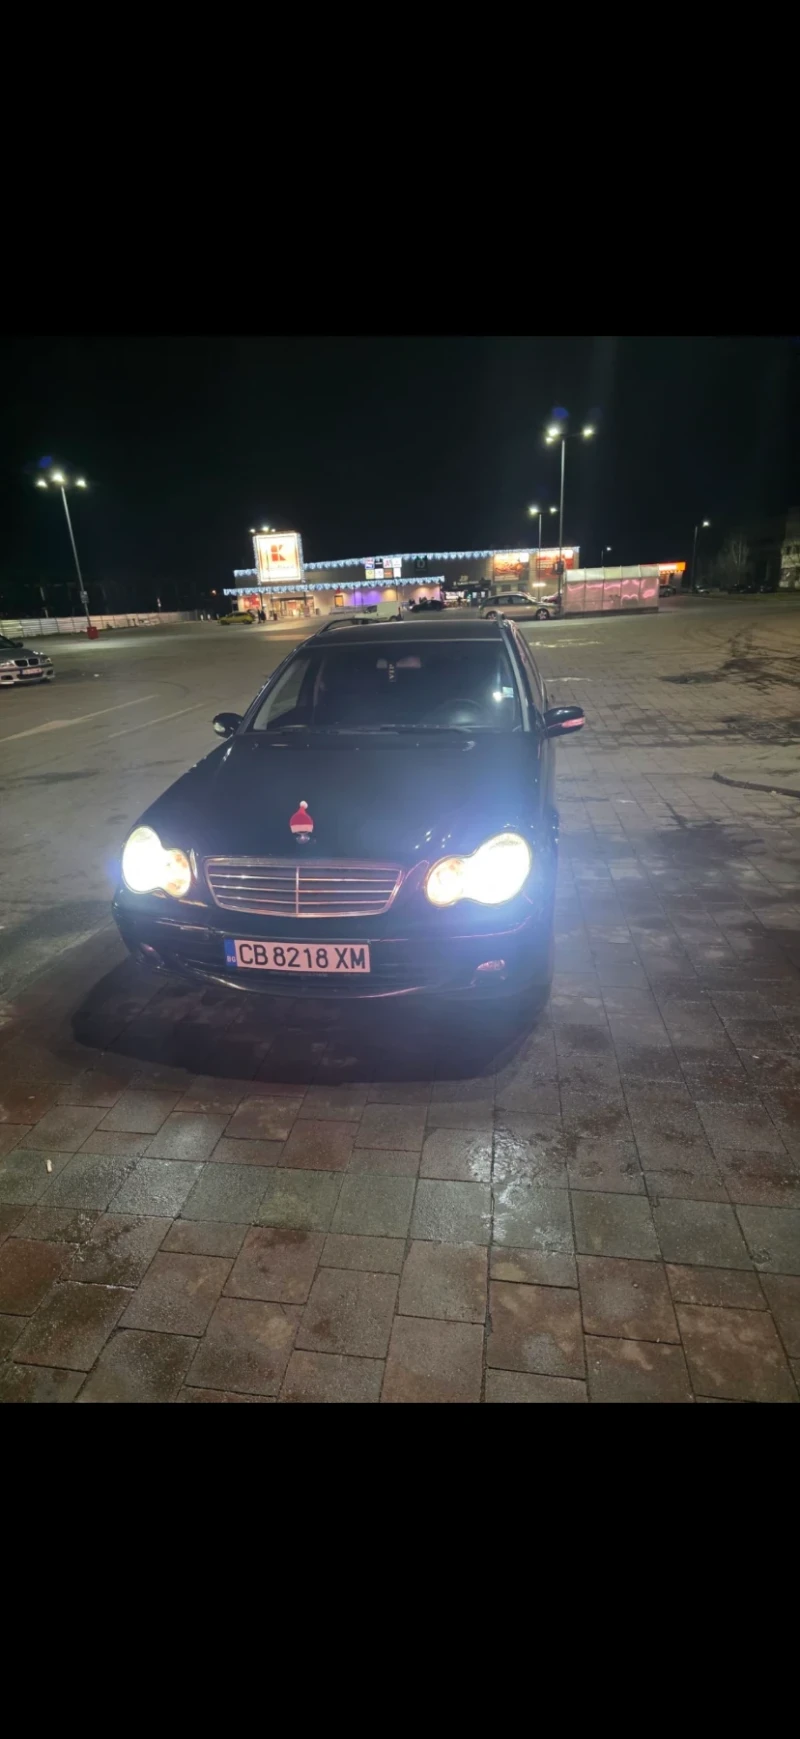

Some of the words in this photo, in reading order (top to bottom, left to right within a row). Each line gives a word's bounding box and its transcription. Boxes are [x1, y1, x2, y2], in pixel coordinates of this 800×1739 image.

[271, 545, 286, 562] K
[227, 955, 236, 963] BG
[238, 943, 268, 966] CB
[272, 946, 329, 969] 8218
[334, 947, 365, 970] XM
